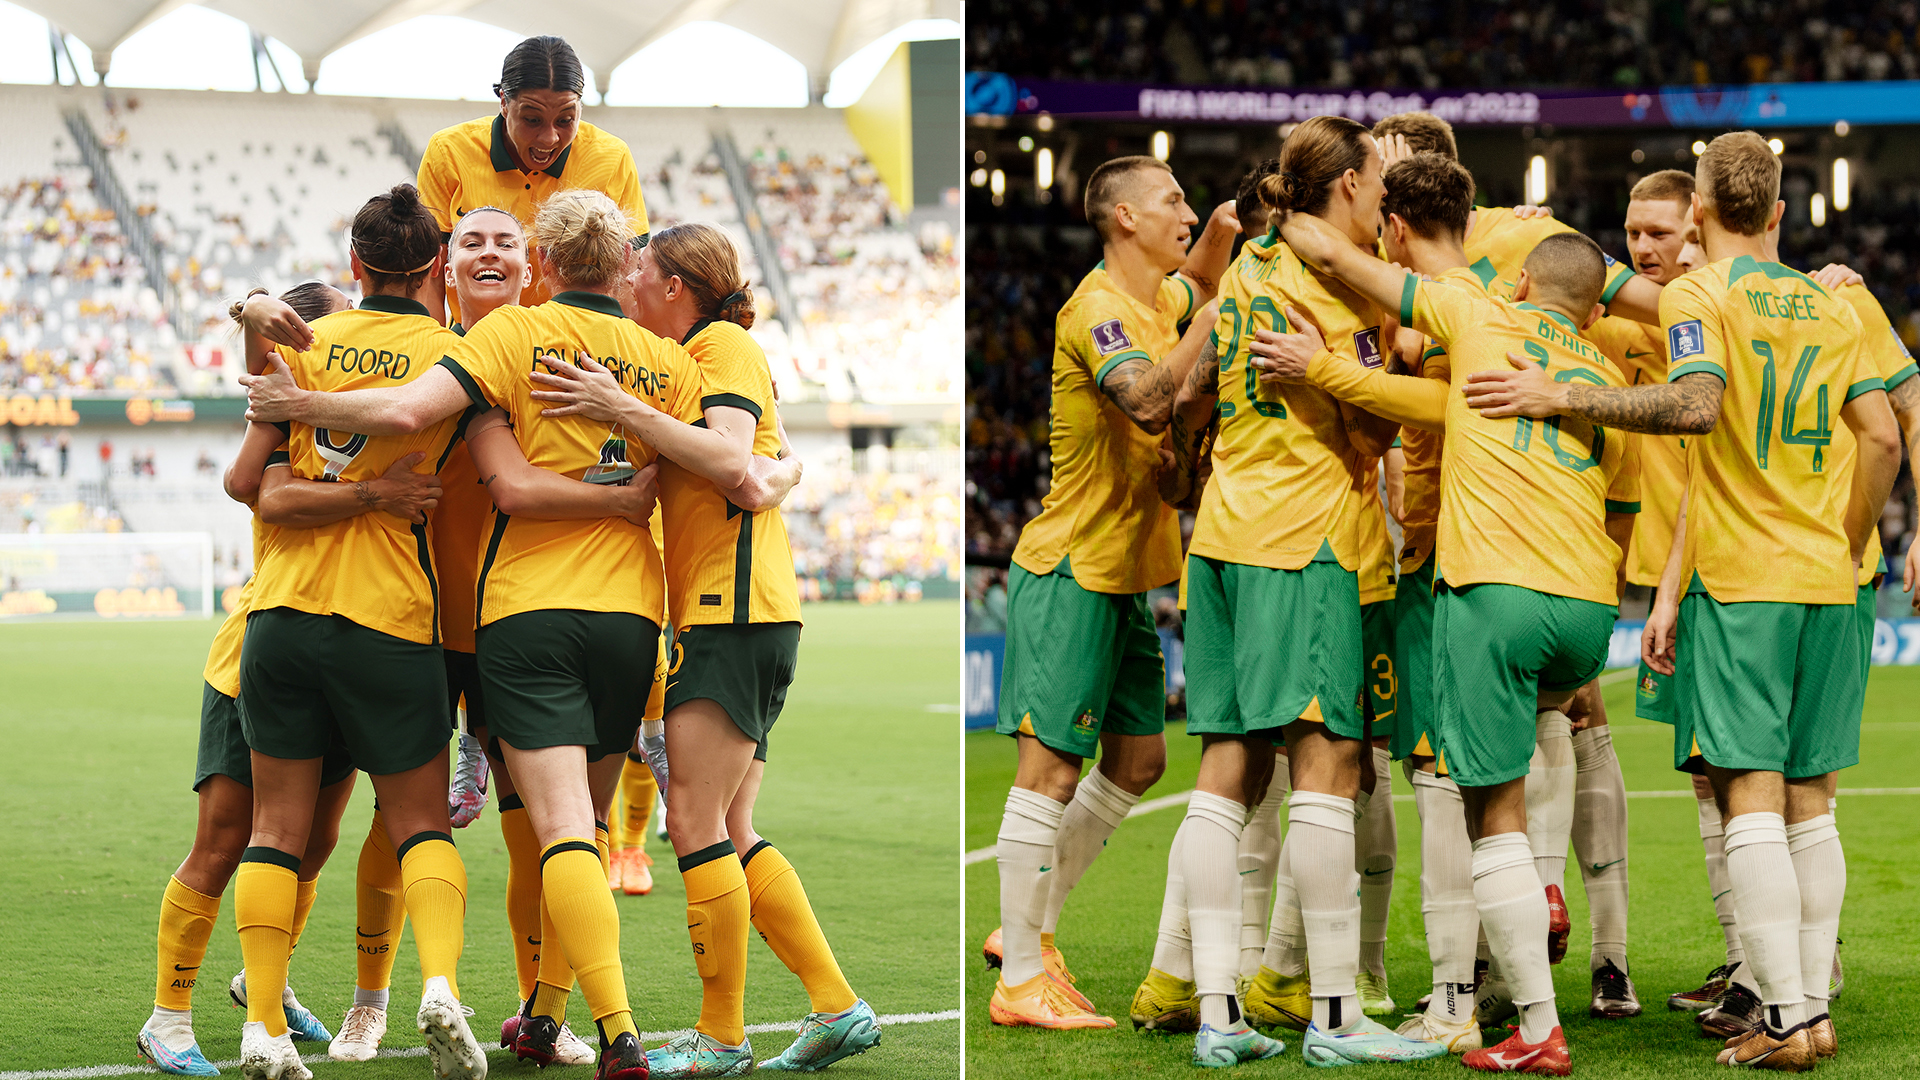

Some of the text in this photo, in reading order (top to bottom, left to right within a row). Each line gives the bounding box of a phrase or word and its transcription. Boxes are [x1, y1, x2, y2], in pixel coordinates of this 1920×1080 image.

[1139, 88, 1196, 119] FIFA
[1197, 90, 1293, 122] WORLD
[1294, 93, 1347, 121] CUP
[1463, 91, 1541, 123] 2022
[325, 343, 411, 380] FOORD
[1751, 339, 1832, 472] 14
[357, 943, 390, 955] AUS
[170, 978, 197, 989] AUS
